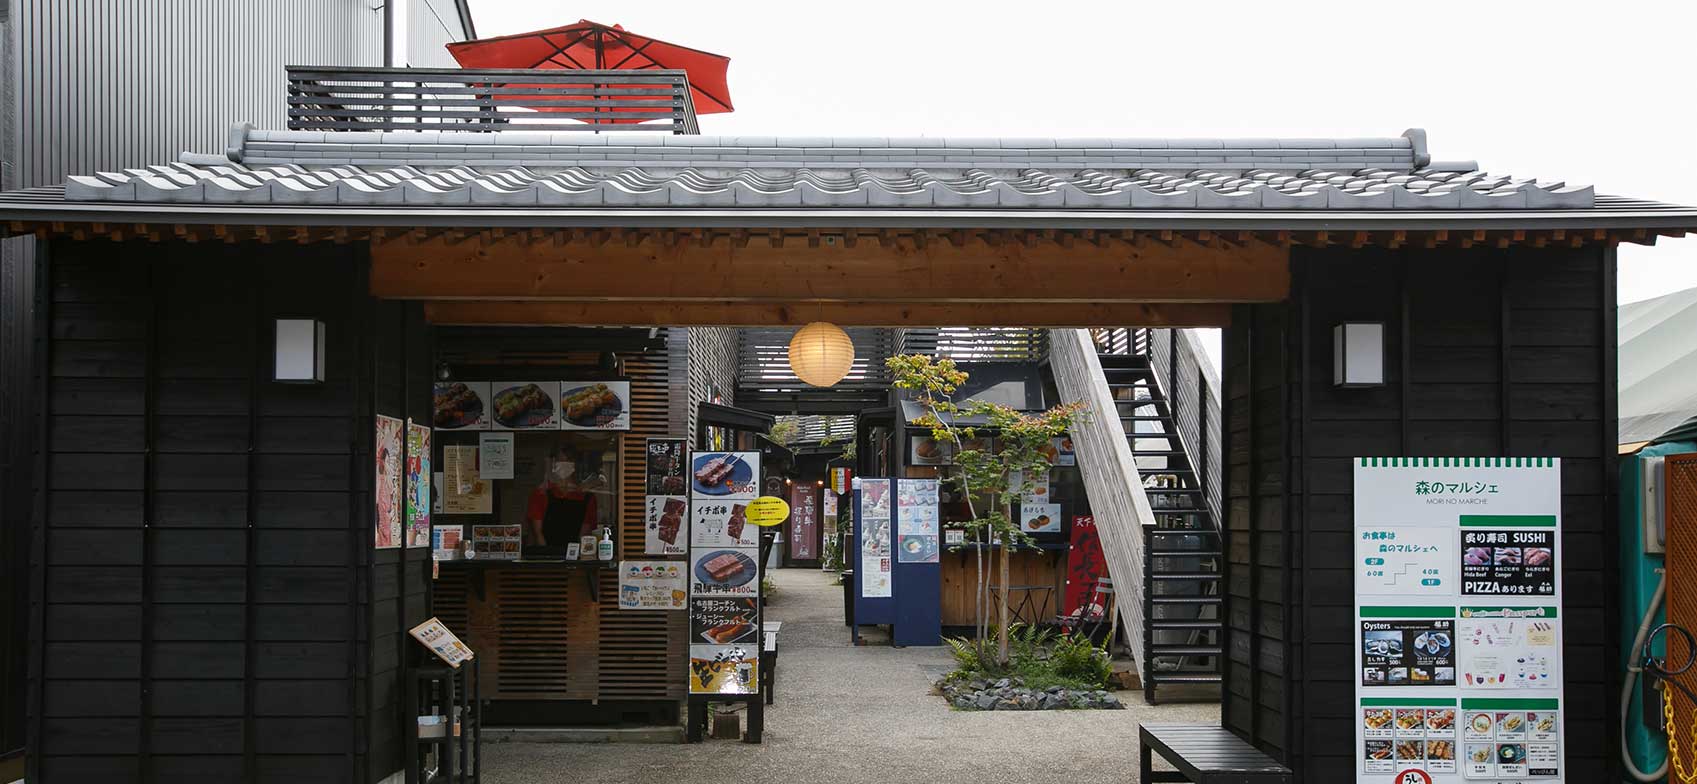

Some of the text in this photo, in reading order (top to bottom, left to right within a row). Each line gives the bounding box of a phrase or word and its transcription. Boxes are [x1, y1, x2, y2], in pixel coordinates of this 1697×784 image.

[1415, 481, 1499, 495] 森のマルシェ
[1362, 531, 1396, 540] お食事は
[1465, 532, 1546, 543] 炙り寿司 SUSHI
[1379, 544, 1439, 553] 森のマルシェへ
[1465, 582, 1534, 593] PIZZA あります
[1363, 622, 1391, 631] Oysters
